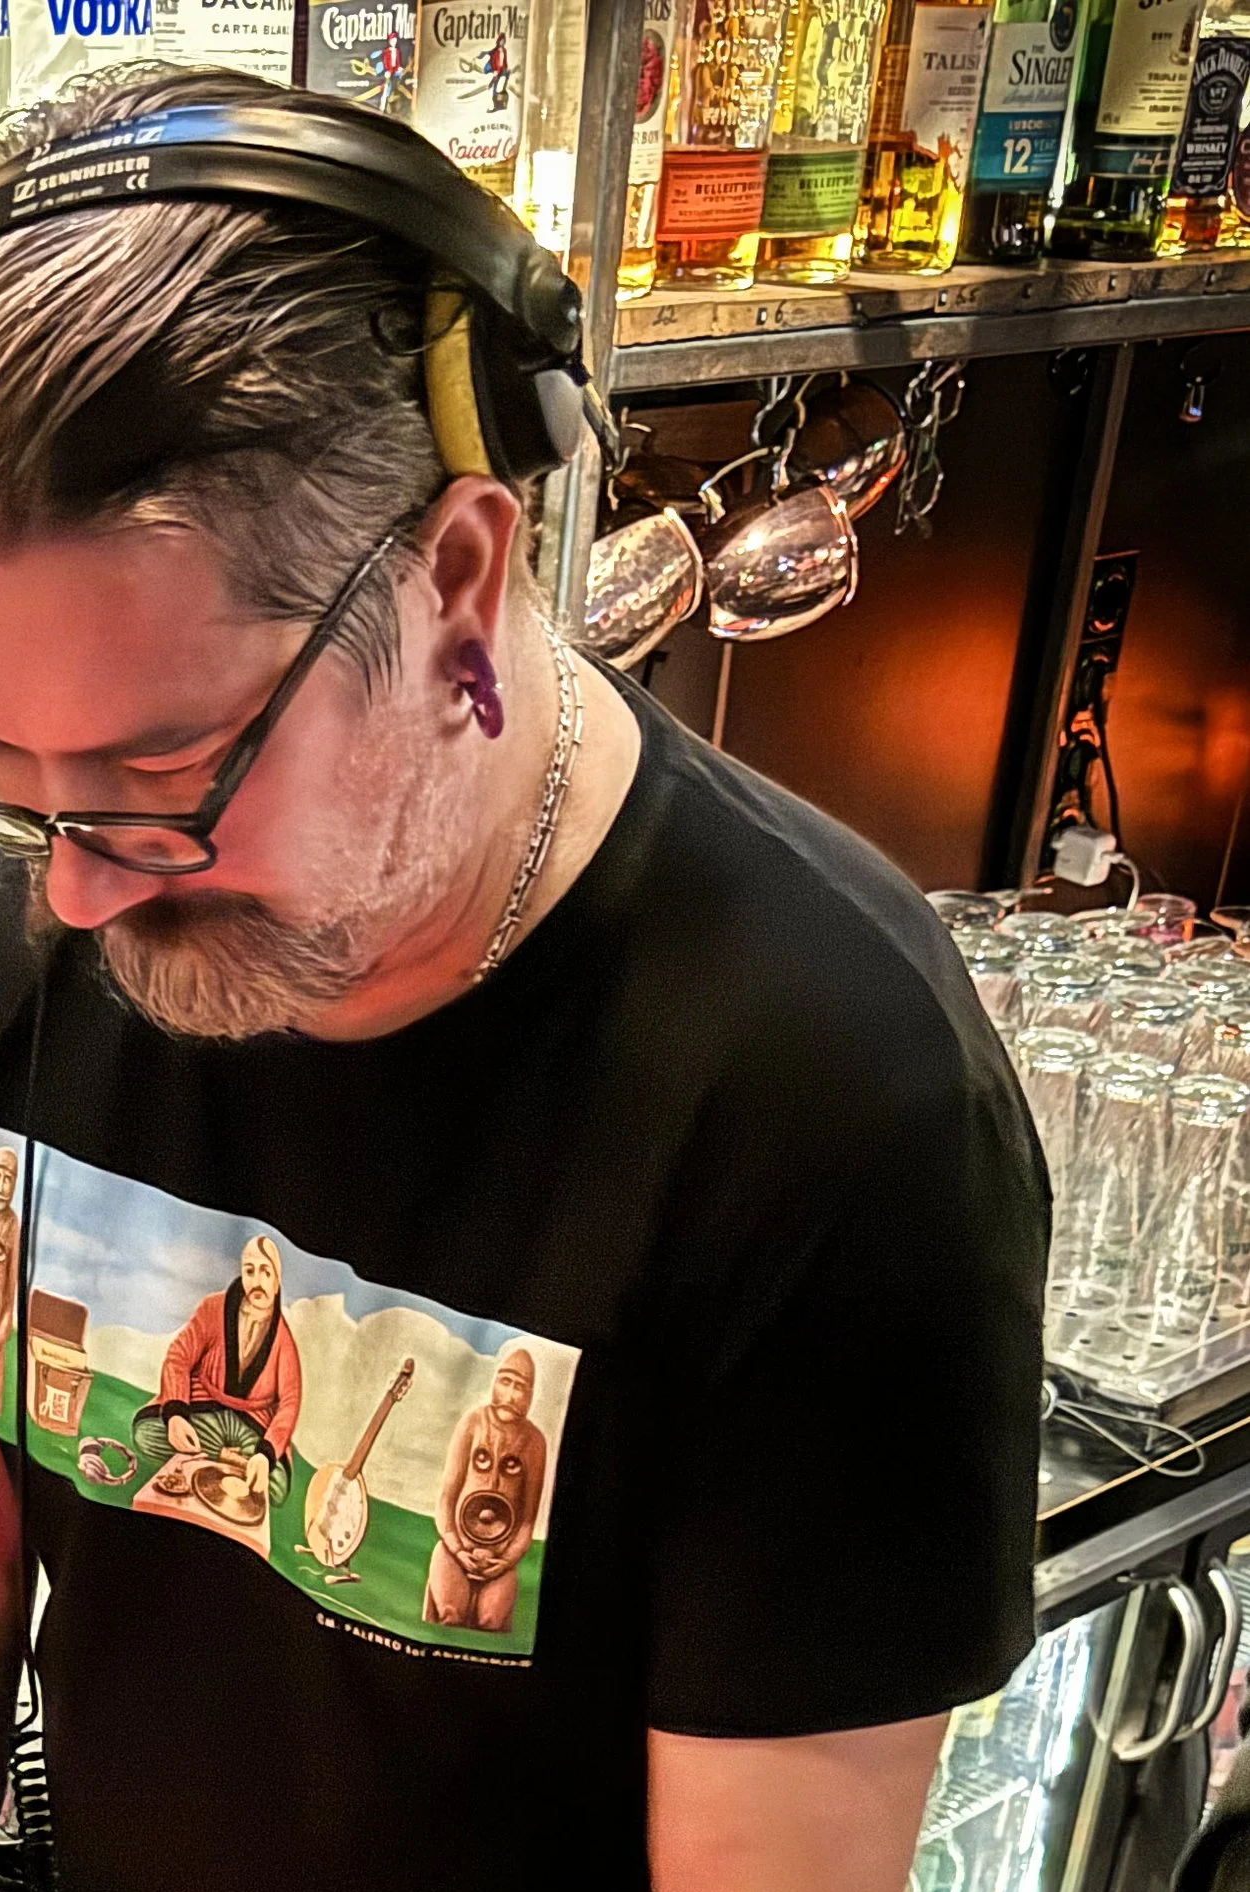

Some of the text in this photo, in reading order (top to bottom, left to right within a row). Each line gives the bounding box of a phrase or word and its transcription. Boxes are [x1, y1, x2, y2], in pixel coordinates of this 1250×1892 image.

[211, 23, 258, 34] CARTA
[321, 4, 393, 49] Captain
[433, 5, 501, 47] Captain
[38, 155, 151, 193] SENNHEISER
[1003, 137, 1033, 174] 12
